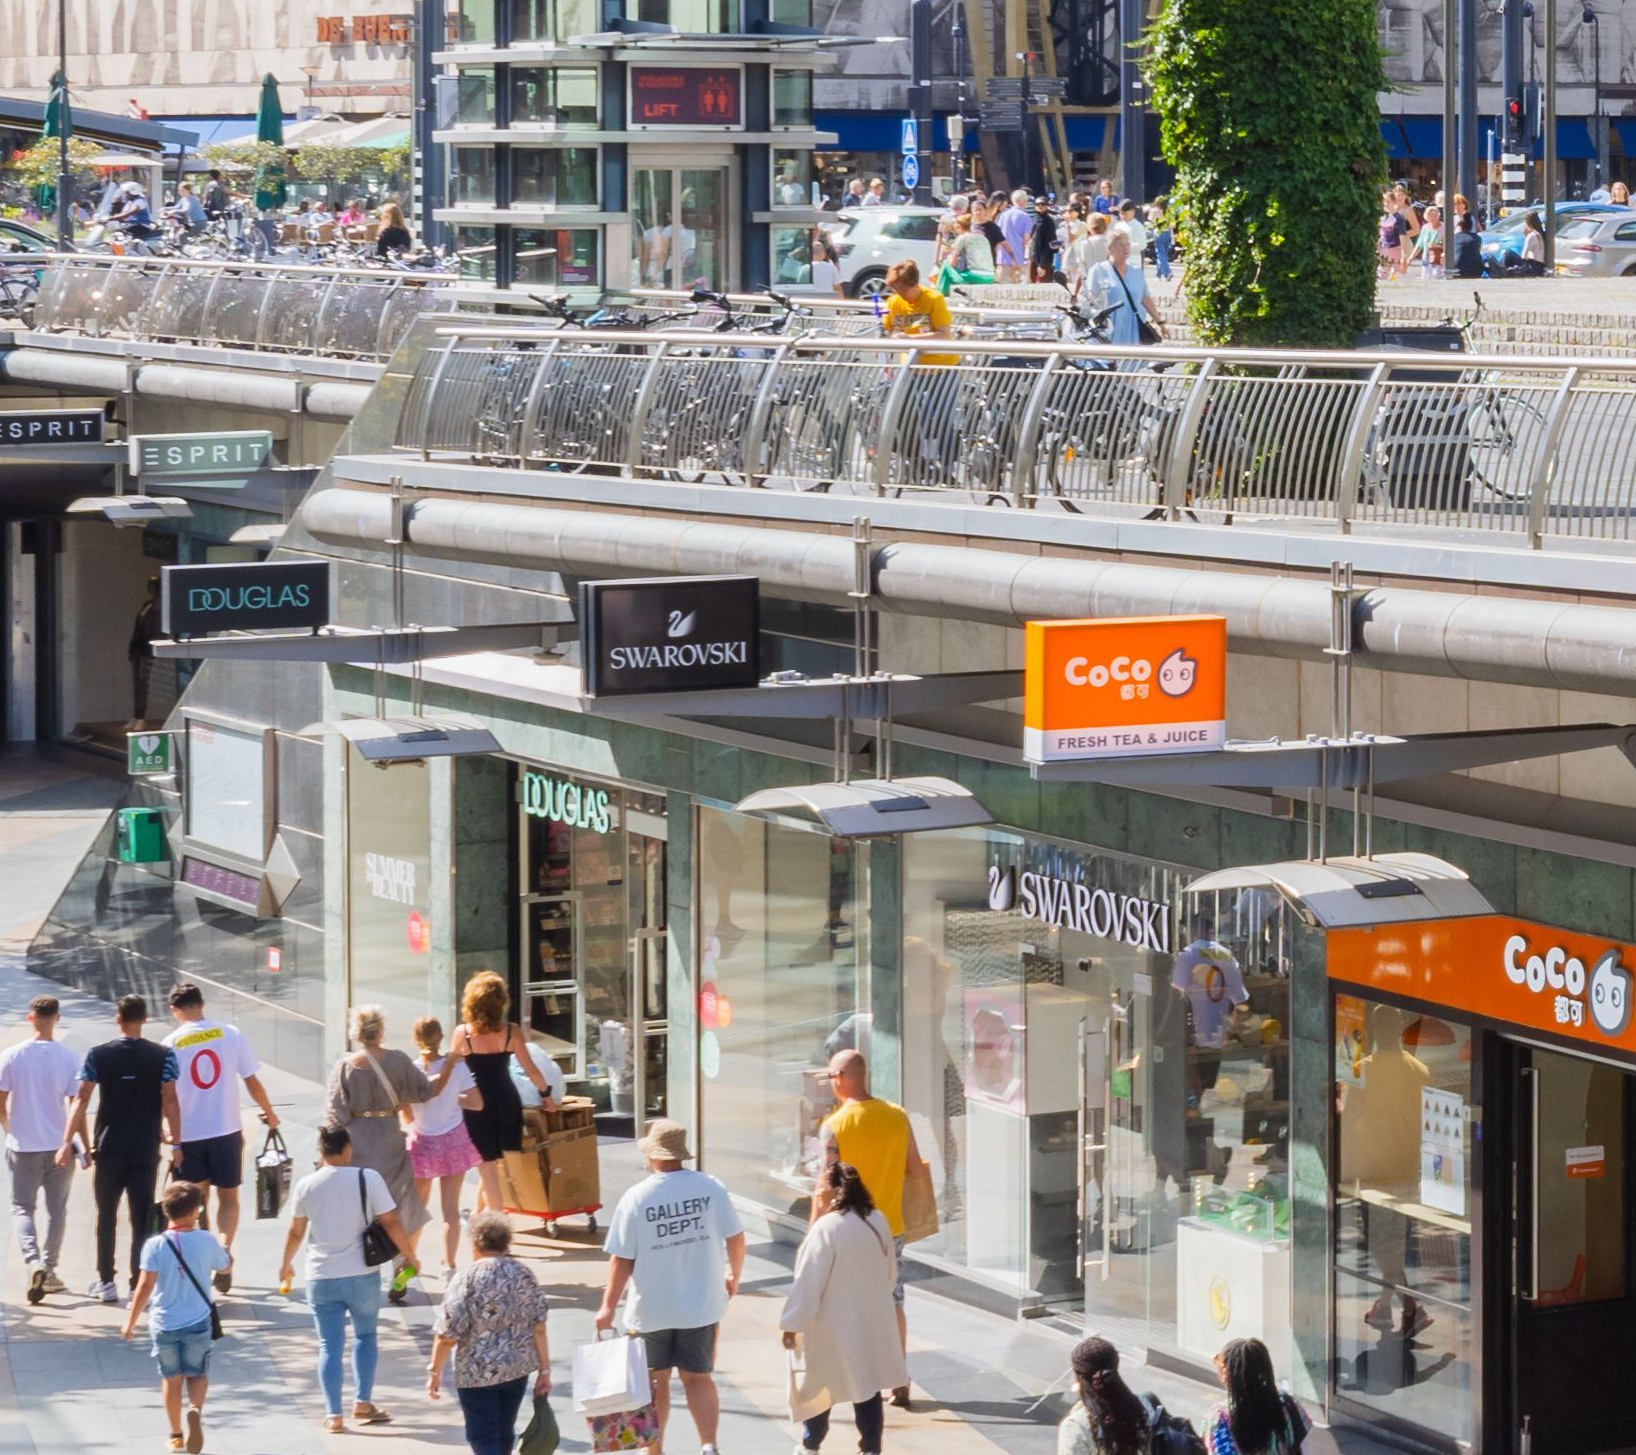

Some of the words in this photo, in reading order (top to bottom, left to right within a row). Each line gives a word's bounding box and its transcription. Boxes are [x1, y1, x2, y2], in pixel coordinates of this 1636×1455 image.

[644, 103, 679, 117] LIFT
[144, 443, 264, 466] ESPRIT
[188, 584, 310, 612] DOUGLAS
[610, 641, 747, 669] SWAROVSKI
[1065, 656, 1152, 688] CoCo
[1057, 735, 1107, 750] FRESH
[1114, 733, 1142, 746] TEA
[1147, 733, 1157, 744] &
[1164, 730, 1208, 744] JUICE
[135, 755, 164, 765] AED
[523, 771, 609, 835] DOUGLAS
[365, 852, 416, 887] SUMMER
[372, 875, 415, 906] BEAUTY
[1020, 871, 1171, 954] SWAROVSKI
[1503, 935, 1586, 997] CoCo
[645, 1195, 712, 1224] GALLERY
[656, 1216, 705, 1239] DEPT.
